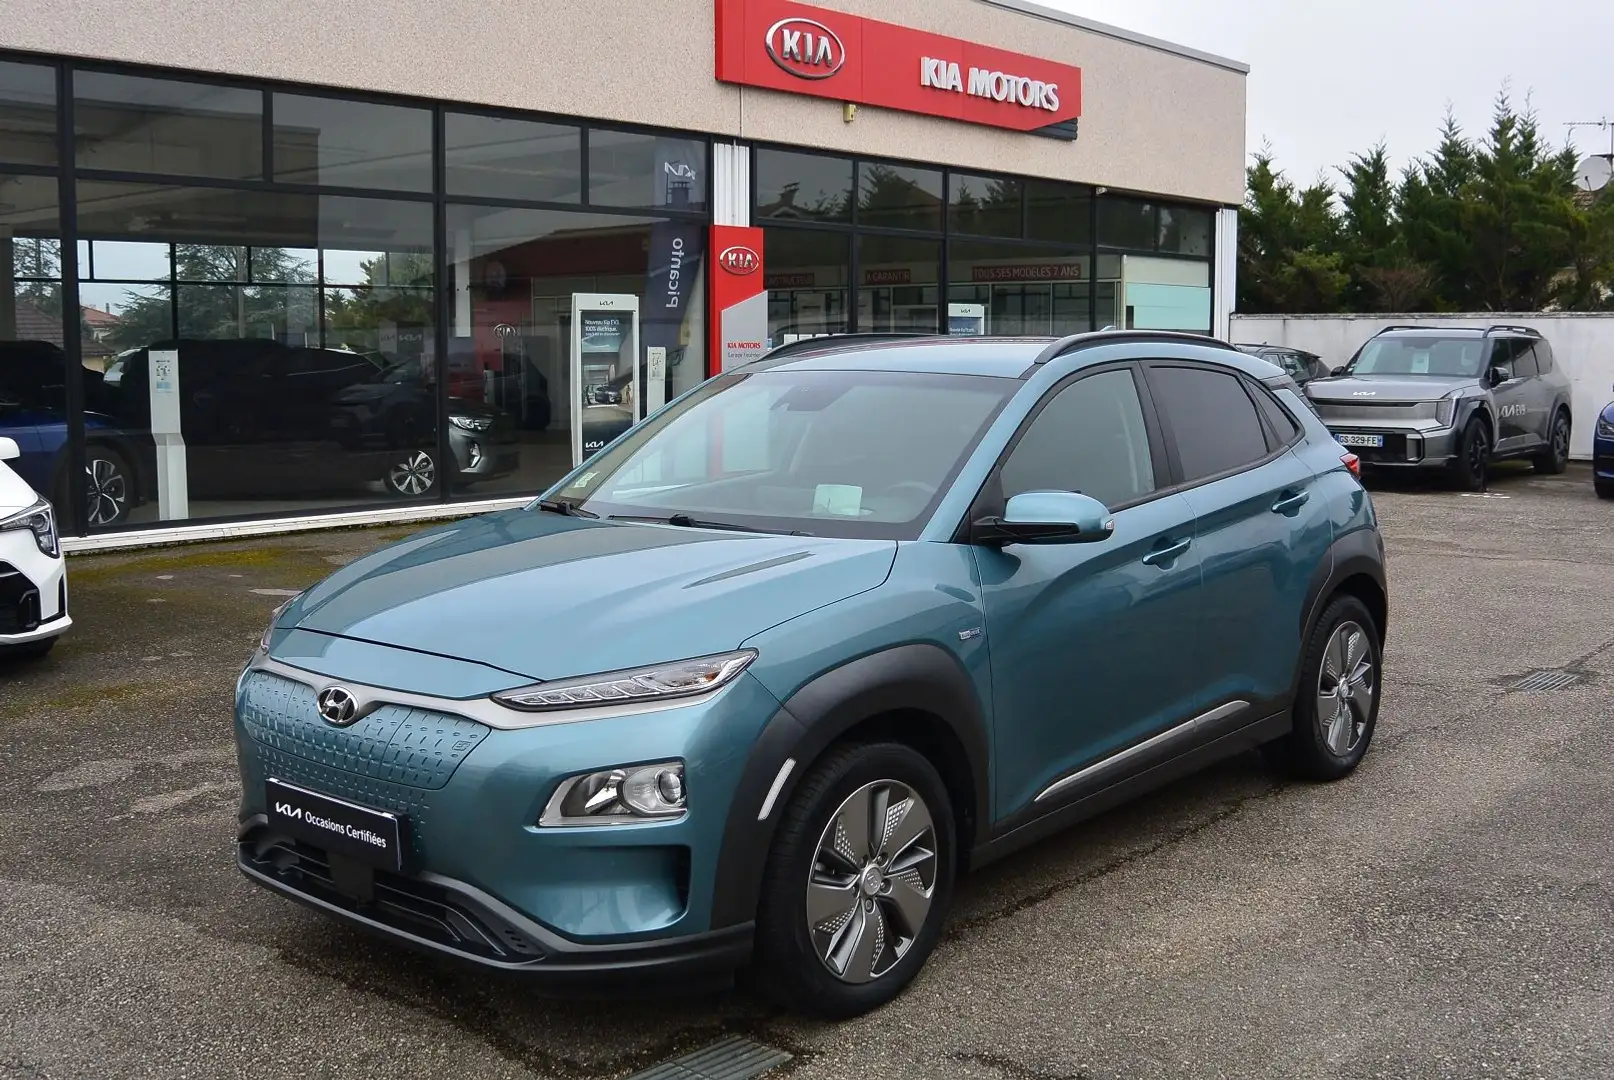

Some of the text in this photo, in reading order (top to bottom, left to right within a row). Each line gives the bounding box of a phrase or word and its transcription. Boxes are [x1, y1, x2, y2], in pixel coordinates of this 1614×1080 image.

[782, 28, 833, 67] KIA
[920, 56, 1060, 112] KIA MOTORS
[727, 252, 754, 269] KIA
[974, 268, 995, 279] TOUS
[996, 268, 1012, 279] SES
[1060, 265, 1080, 277] ANS
[585, 440, 604, 448] KIA
[1339, 435, 1377, 445] GS-329-FE
[275, 801, 387, 849] KIA Occasions Certifiées
